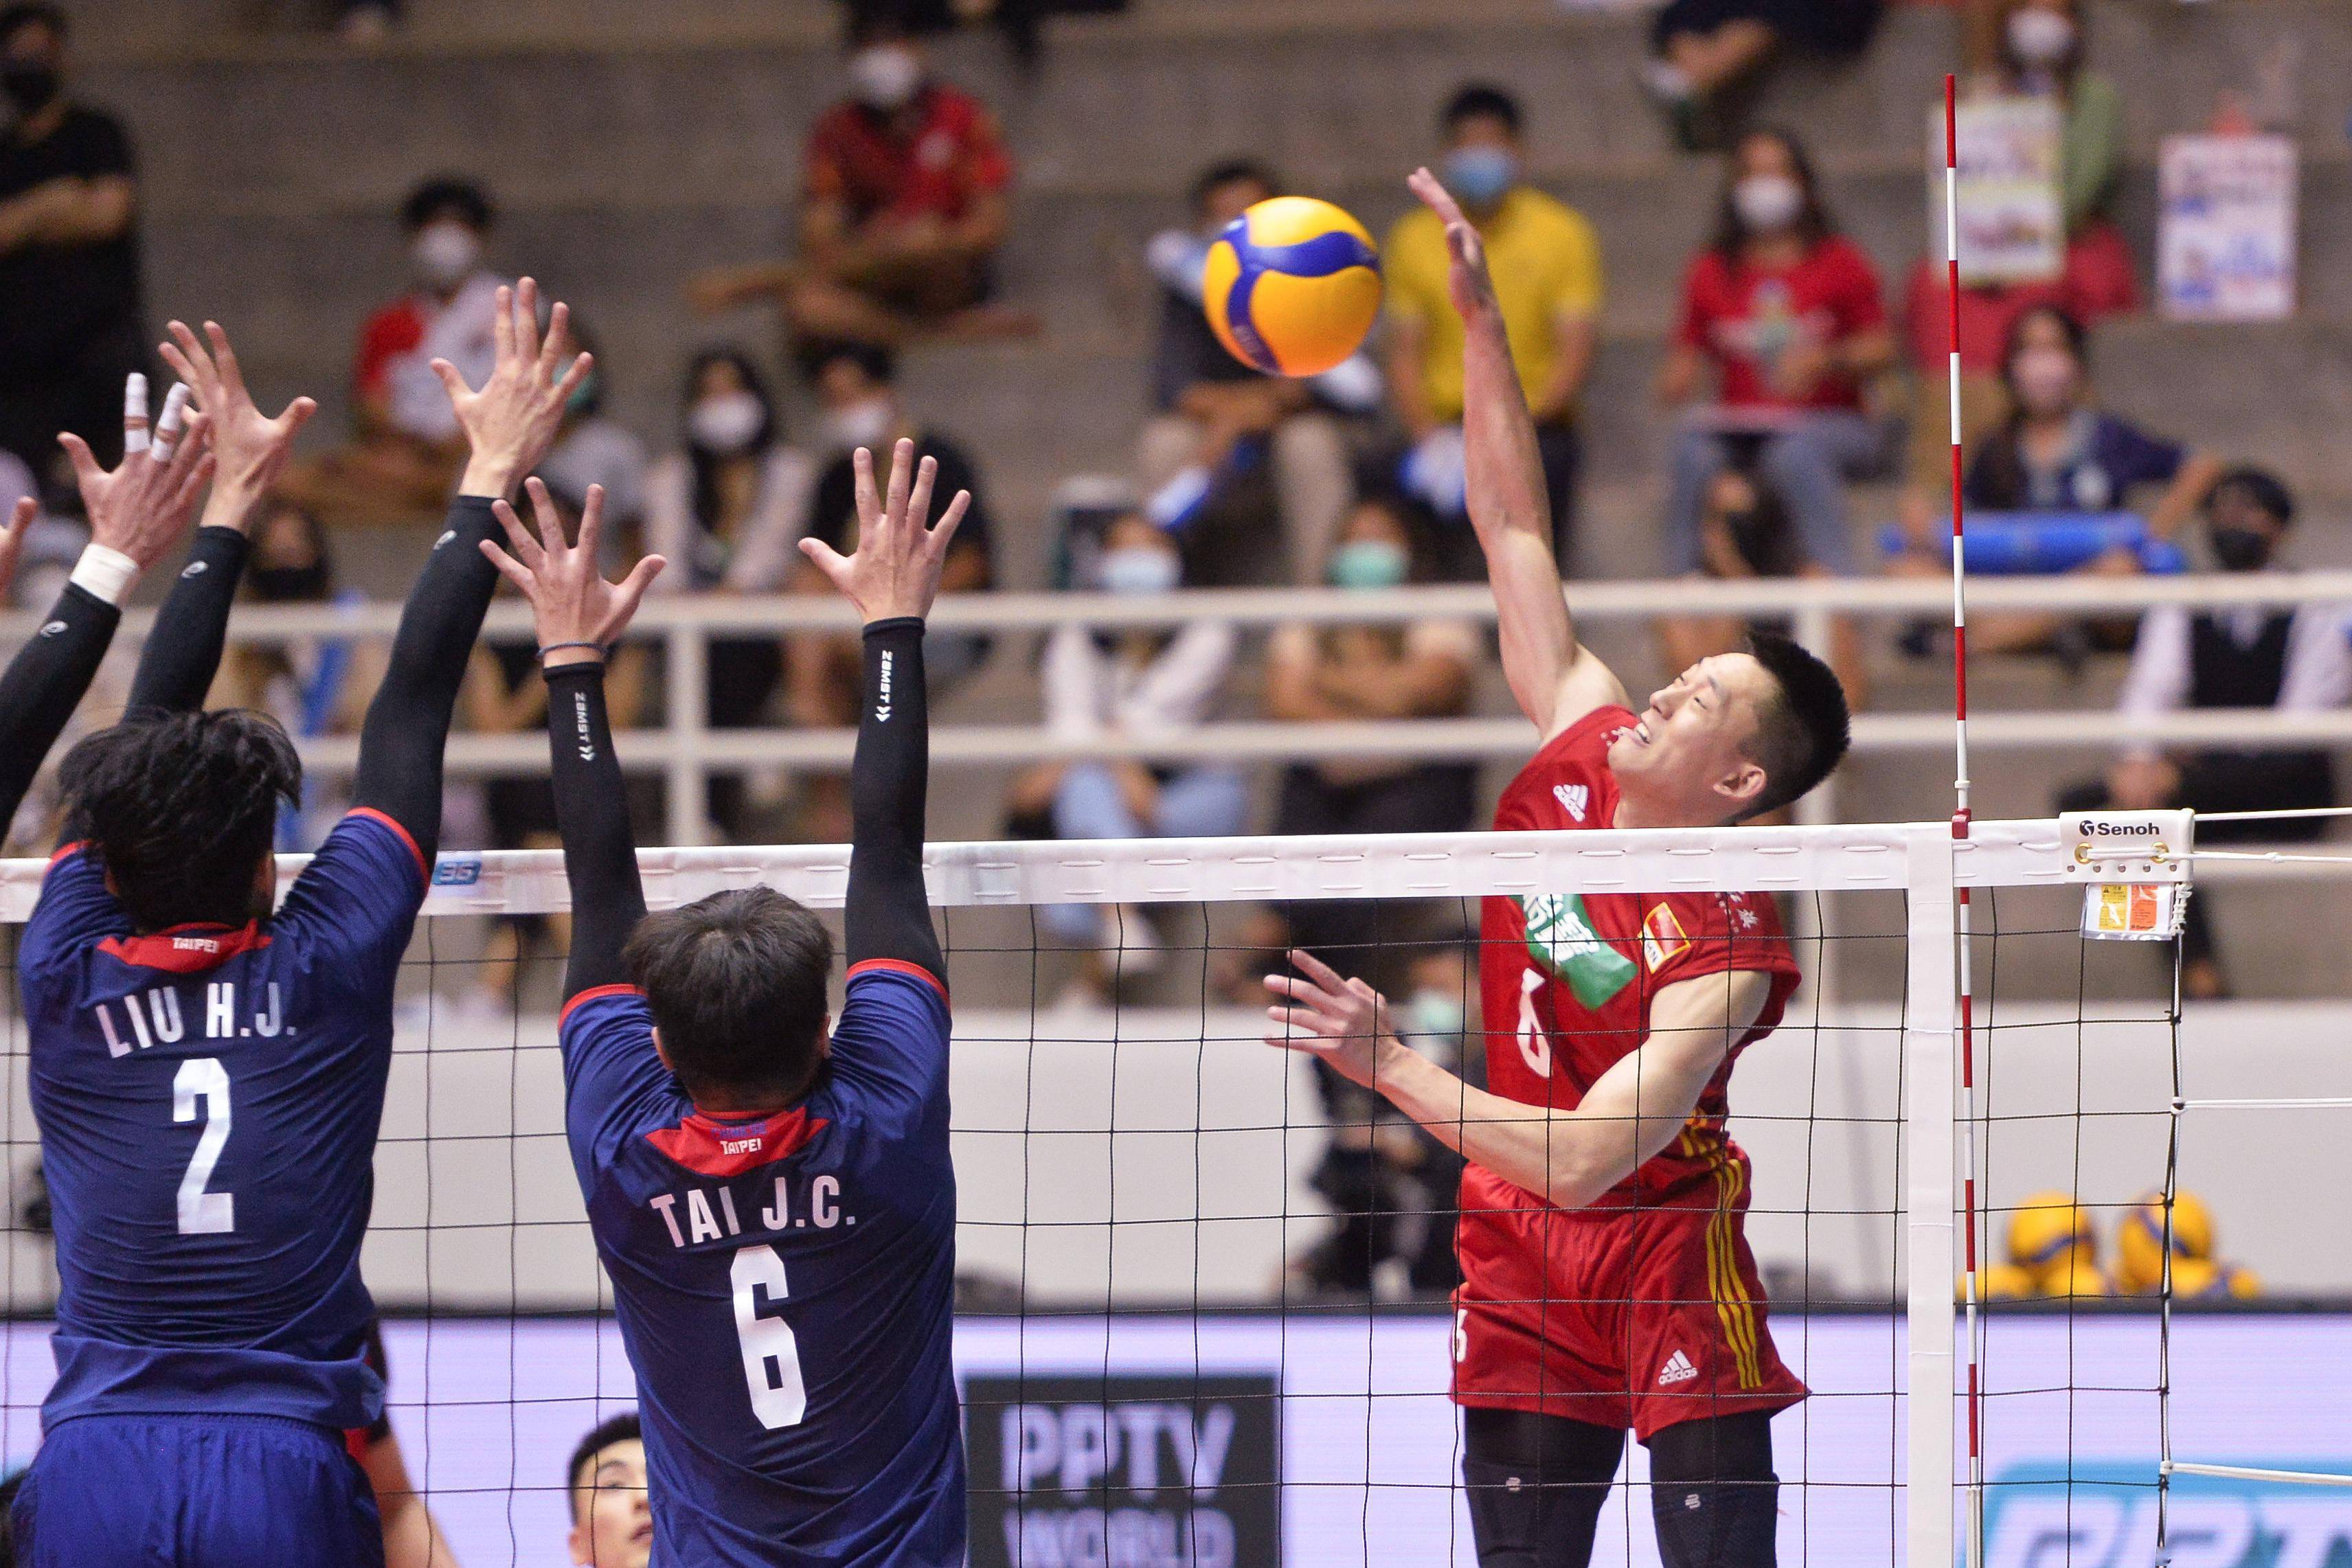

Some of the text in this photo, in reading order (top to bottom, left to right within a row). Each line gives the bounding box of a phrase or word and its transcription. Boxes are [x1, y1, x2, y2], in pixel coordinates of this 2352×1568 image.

[2097, 822, 2160, 836] Senoh
[170, 938, 219, 954] TAIPEI
[95, 982, 297, 1058] LIU H.J.
[173, 1058, 235, 1234] 2
[720, 1137, 762, 1155] TAIPEI
[649, 1175, 856, 1247] TAI J.C.
[730, 1244, 807, 1430] 6
[1659, 1367, 1698, 1385] adidas
[1001, 1402, 1236, 1501] PPTV
